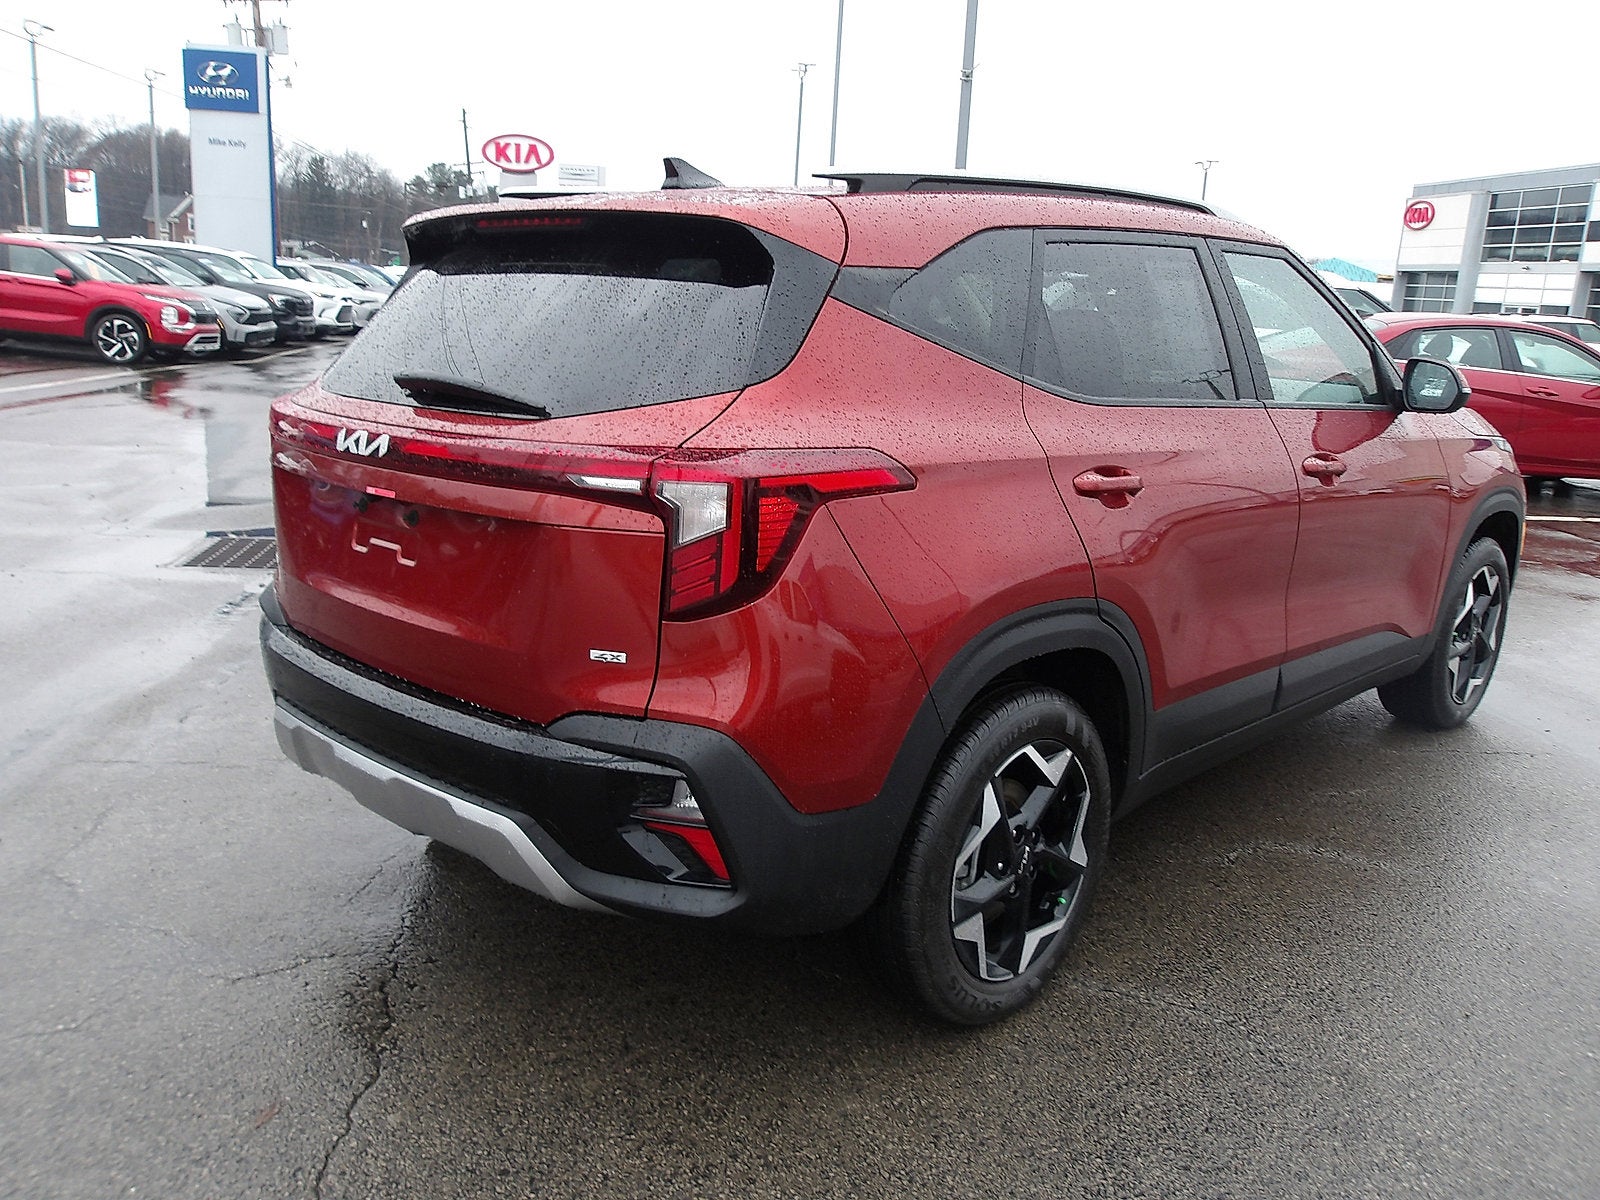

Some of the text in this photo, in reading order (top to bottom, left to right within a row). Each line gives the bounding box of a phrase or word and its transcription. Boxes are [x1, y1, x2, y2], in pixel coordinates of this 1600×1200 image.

[189, 85, 249, 101] HYUNDAI
[494, 140, 545, 166] KIA
[1407, 207, 1429, 224] KIA
